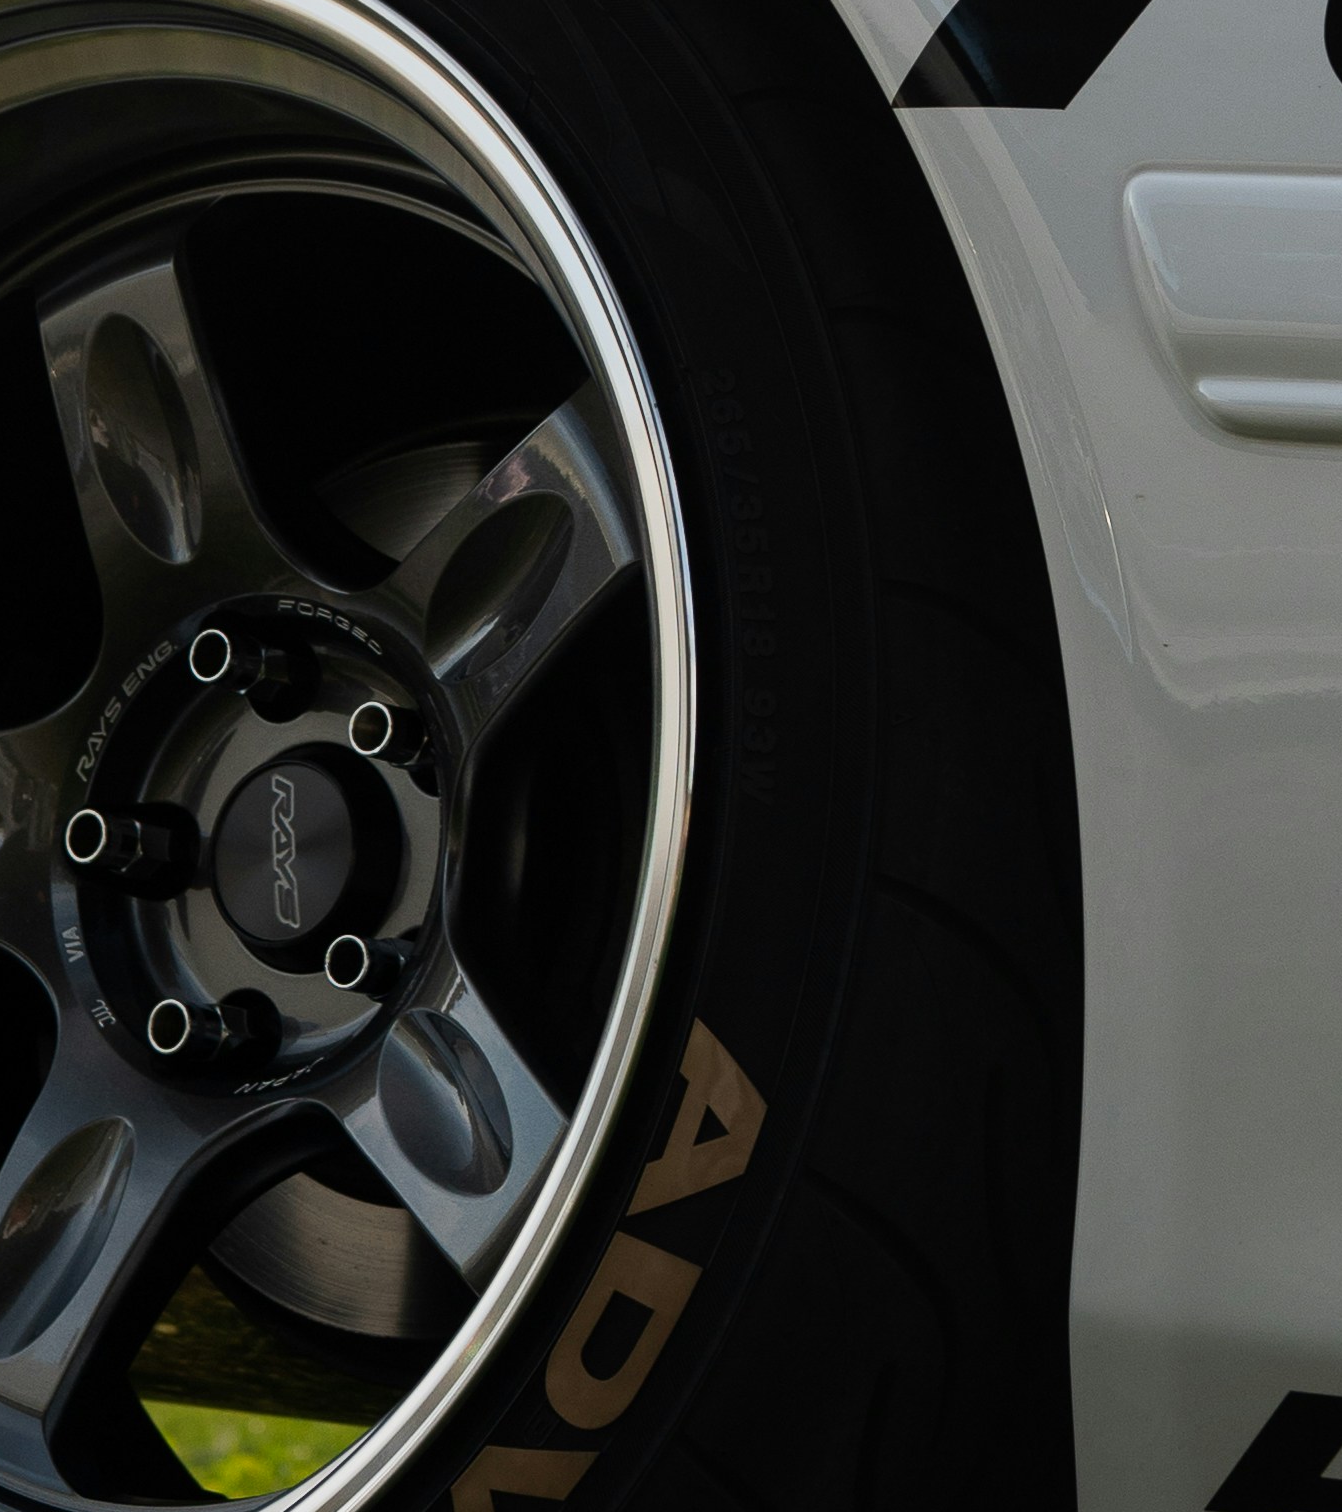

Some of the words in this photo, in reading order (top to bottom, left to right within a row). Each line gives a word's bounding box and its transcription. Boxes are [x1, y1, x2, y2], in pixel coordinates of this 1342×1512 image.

[700, 366, 779, 658] 265/35R18
[277, 599, 383, 656] FORGED
[75, 696, 122, 782] RAYS
[121, 639, 179, 697] ENG.
[271, 773, 300, 930] RAYS
[61, 925, 85, 963] VIA
[233, 1056, 325, 1095] JAPAN
